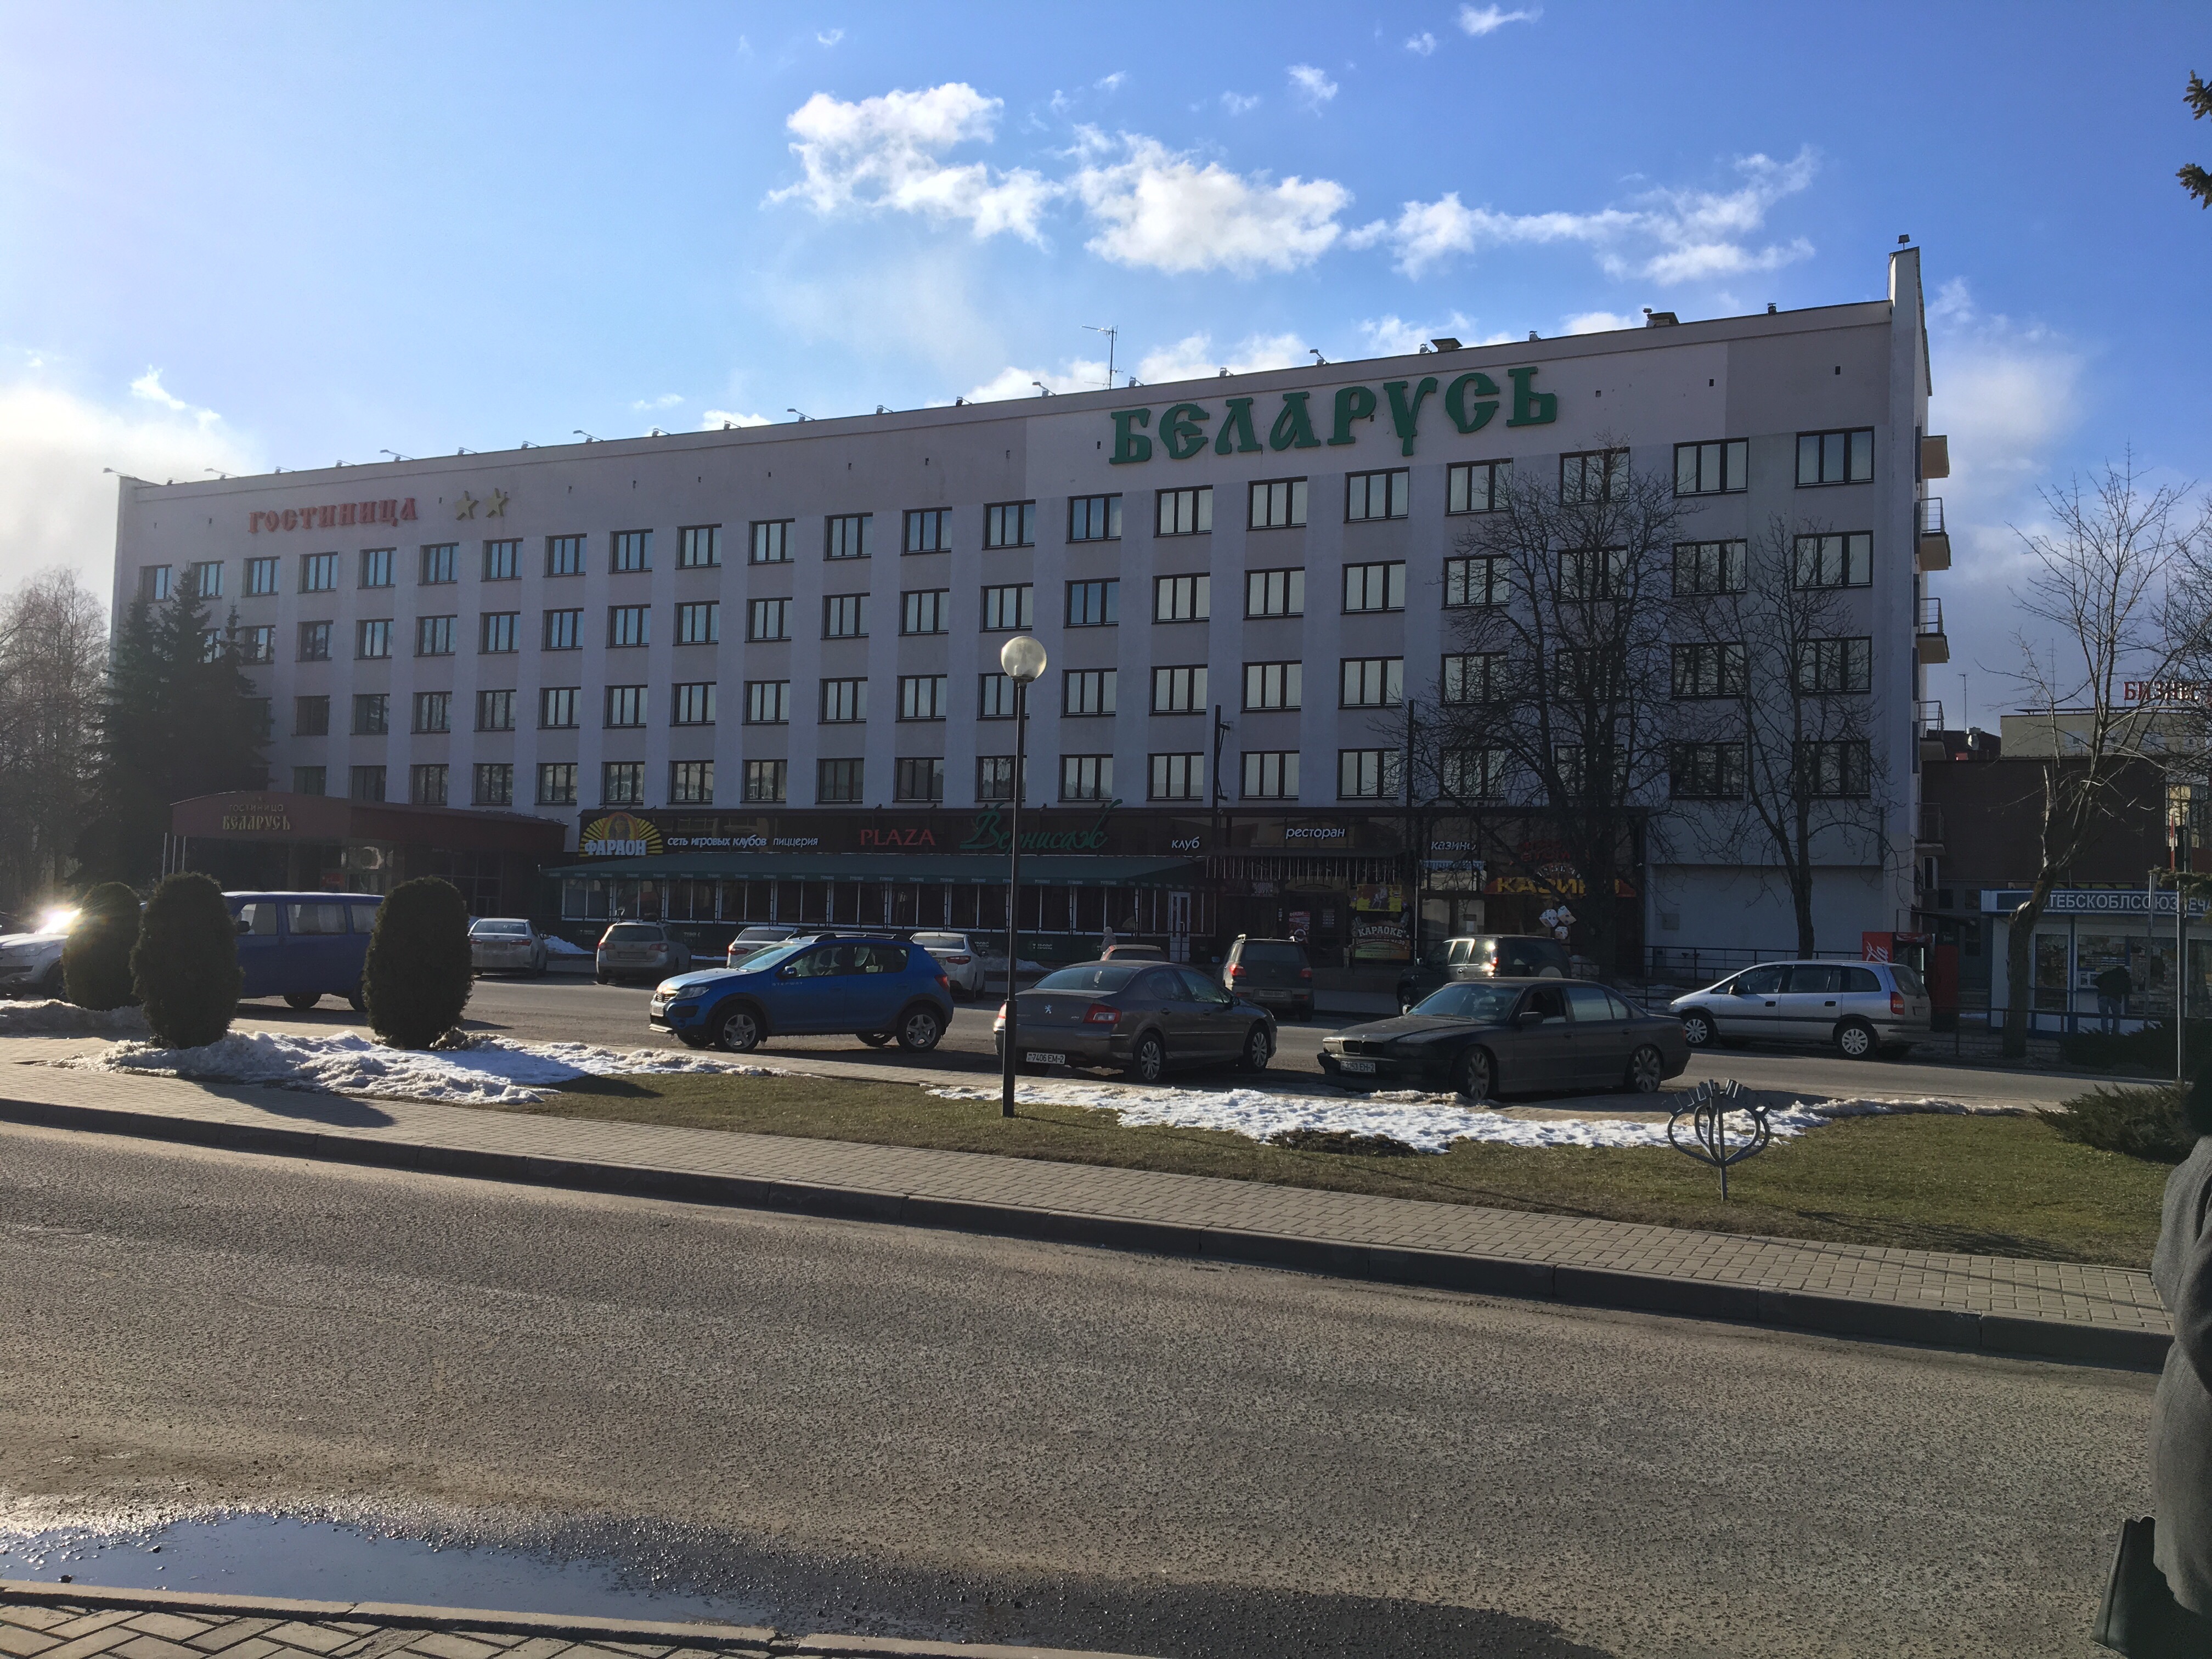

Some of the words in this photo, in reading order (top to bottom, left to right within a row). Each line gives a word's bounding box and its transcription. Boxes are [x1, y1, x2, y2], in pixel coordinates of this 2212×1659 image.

[1109, 366, 1558, 465] БЕЛАРУСЬ
[247, 497, 417, 534] ГОСТИНИЦА
[2124, 681, 2199, 701] БИЗНЕС
[667, 837, 688, 846] сеть
[690, 837, 730, 848] игровых
[732, 833, 767, 849] клубов
[860, 829, 936, 846] PLAZA
[1285, 827, 1346, 840] ресторан
[584, 839, 647, 856] ФАРАОН
[772, 837, 818, 848] пиццерия
[1171, 836, 1200, 851] клуб
[1496, 877, 1620, 895] КАЗИ
[1357, 926, 1403, 938] КАРАОКЕ
[1032, 1053, 1047, 1062] 7406
[1047, 1054, 1064, 1063] EM-2
